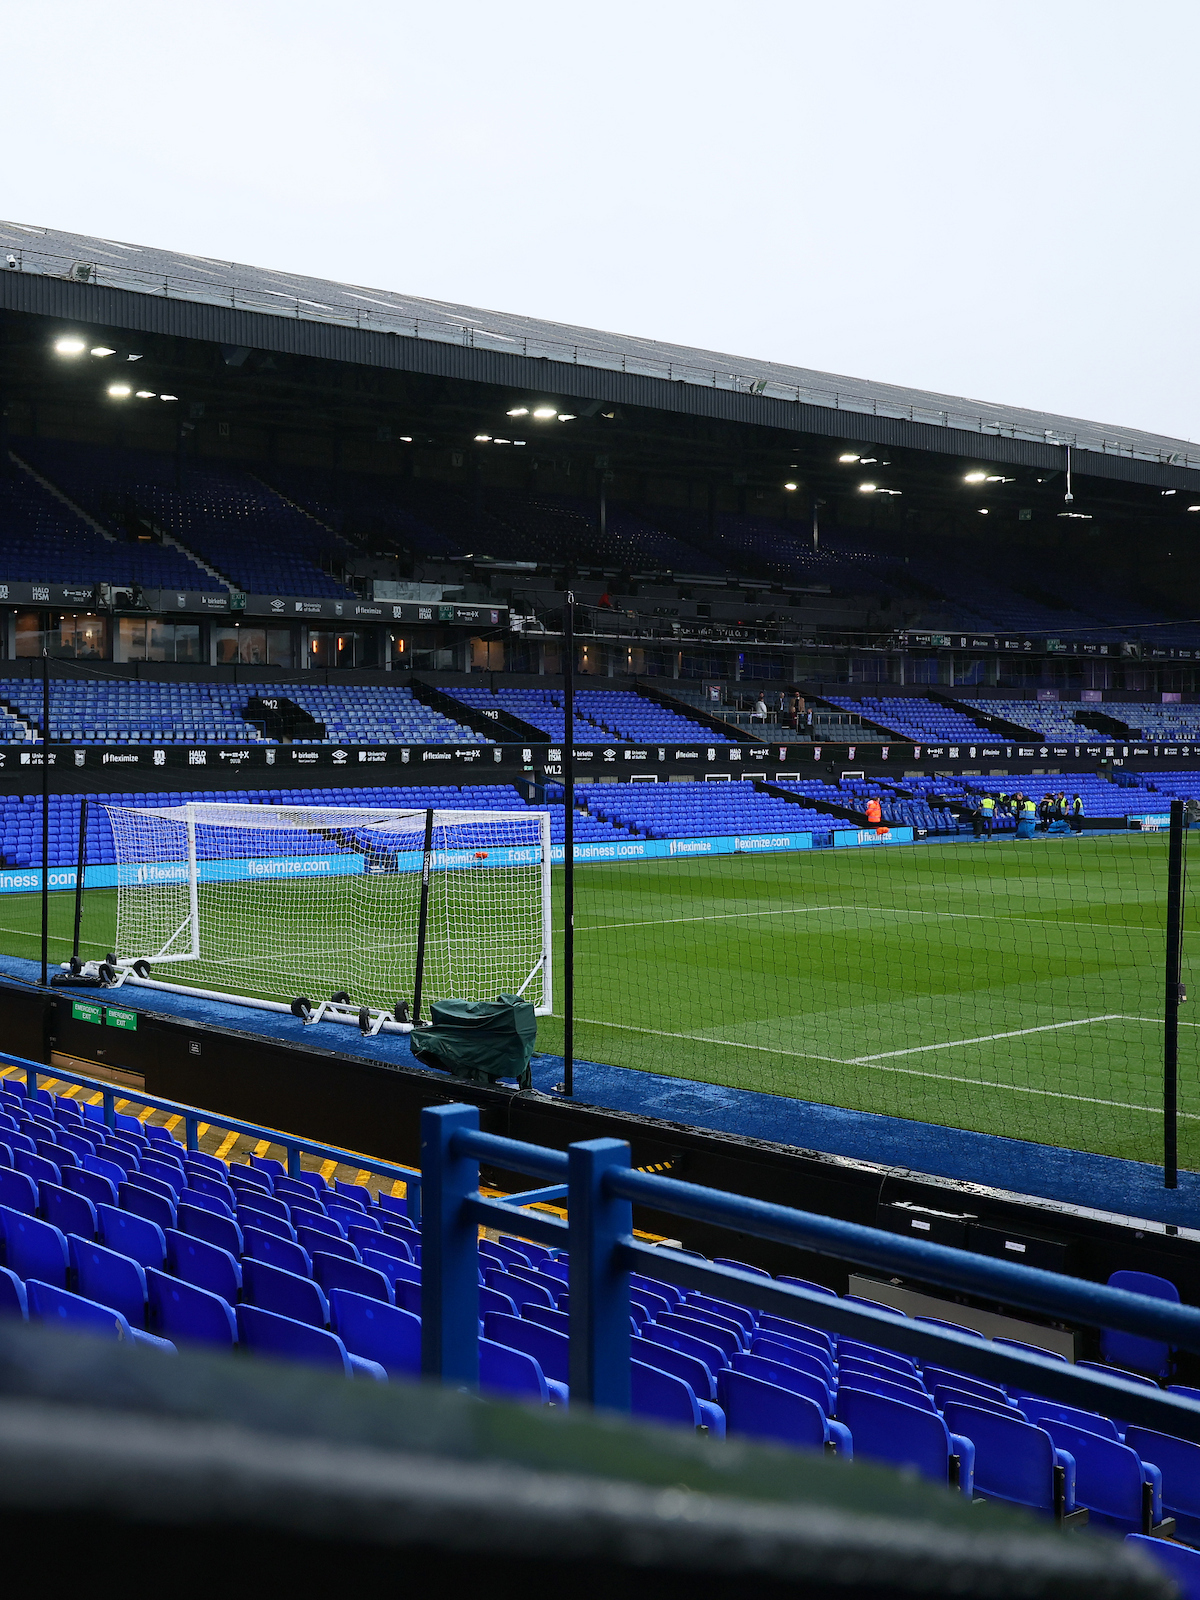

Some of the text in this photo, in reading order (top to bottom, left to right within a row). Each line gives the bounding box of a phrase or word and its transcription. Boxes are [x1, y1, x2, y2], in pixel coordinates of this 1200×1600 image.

[32, 586, 50, 594] HALO
[32, 593, 50, 601] ITSM
[110, 753, 139, 762] fleximize
[189, 750, 207, 758] HALO
[428, 752, 452, 760] fleximize
[189, 757, 207, 765] ITSM
[543, 764, 563, 775] WL2
[677, 840, 712, 853] fleximize
[735, 837, 790, 850] fleximize.com
[508, 849, 533, 863] Fast,
[573, 845, 615, 858] Business
[616, 844, 645, 856] Loans
[248, 860, 331, 875] fleximize.com
[75, 1003, 99, 1015] EMERGENCY
[82, 1012, 92, 1020] EXIT
[109, 1010, 134, 1021] EMERGENCY
[116, 1019, 126, 1027] EXIT
